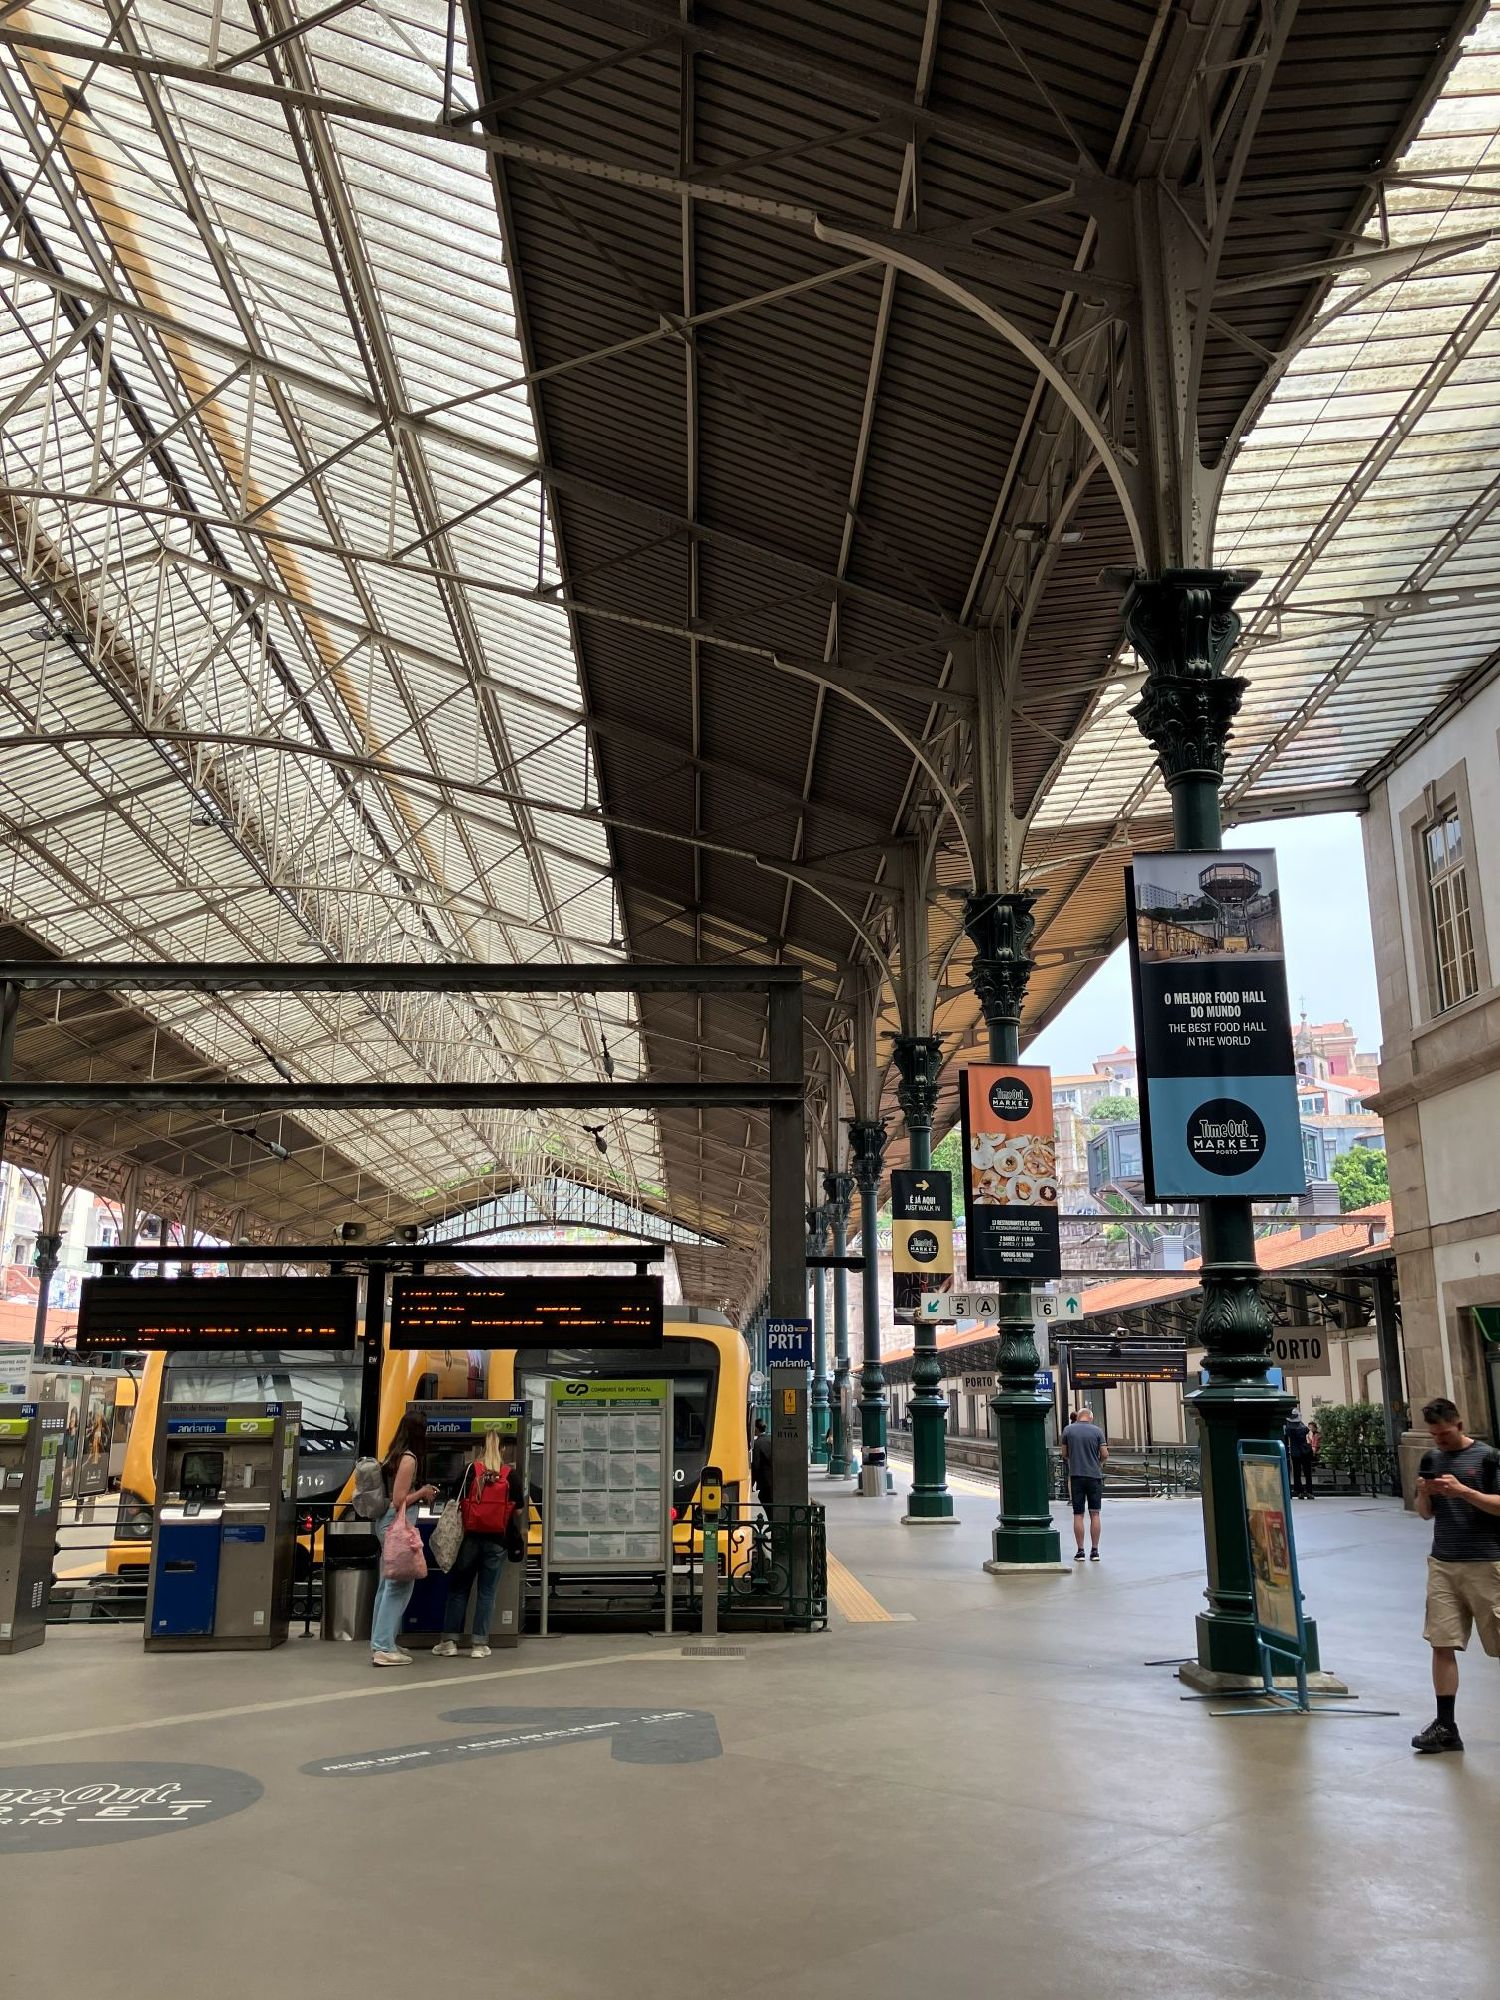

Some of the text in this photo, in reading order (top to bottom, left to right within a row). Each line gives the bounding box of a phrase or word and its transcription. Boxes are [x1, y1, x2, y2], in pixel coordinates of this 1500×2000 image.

[1164, 991, 1266, 1004] O MELHOR FOOD HALL
[1190, 1005, 1241, 1017] DO MUNDO
[1168, 1022, 1267, 1033] THE BEST FOOD HALL
[1187, 1036, 1251, 1046] IN THE WORLD
[1194, 1139, 1258, 1148] MARKET
[922, 1196, 936, 1205] AQUI
[956, 1303, 964, 1315] 5
[980, 1301, 991, 1313] A
[1043, 1303, 1052, 1315] 6
[768, 1324, 793, 1332] zona
[768, 1334, 802, 1349] PRT1
[769, 1357, 810, 1368] andante
[965, 1376, 993, 1387] PORTO
[178, 1422, 216, 1432] andante
